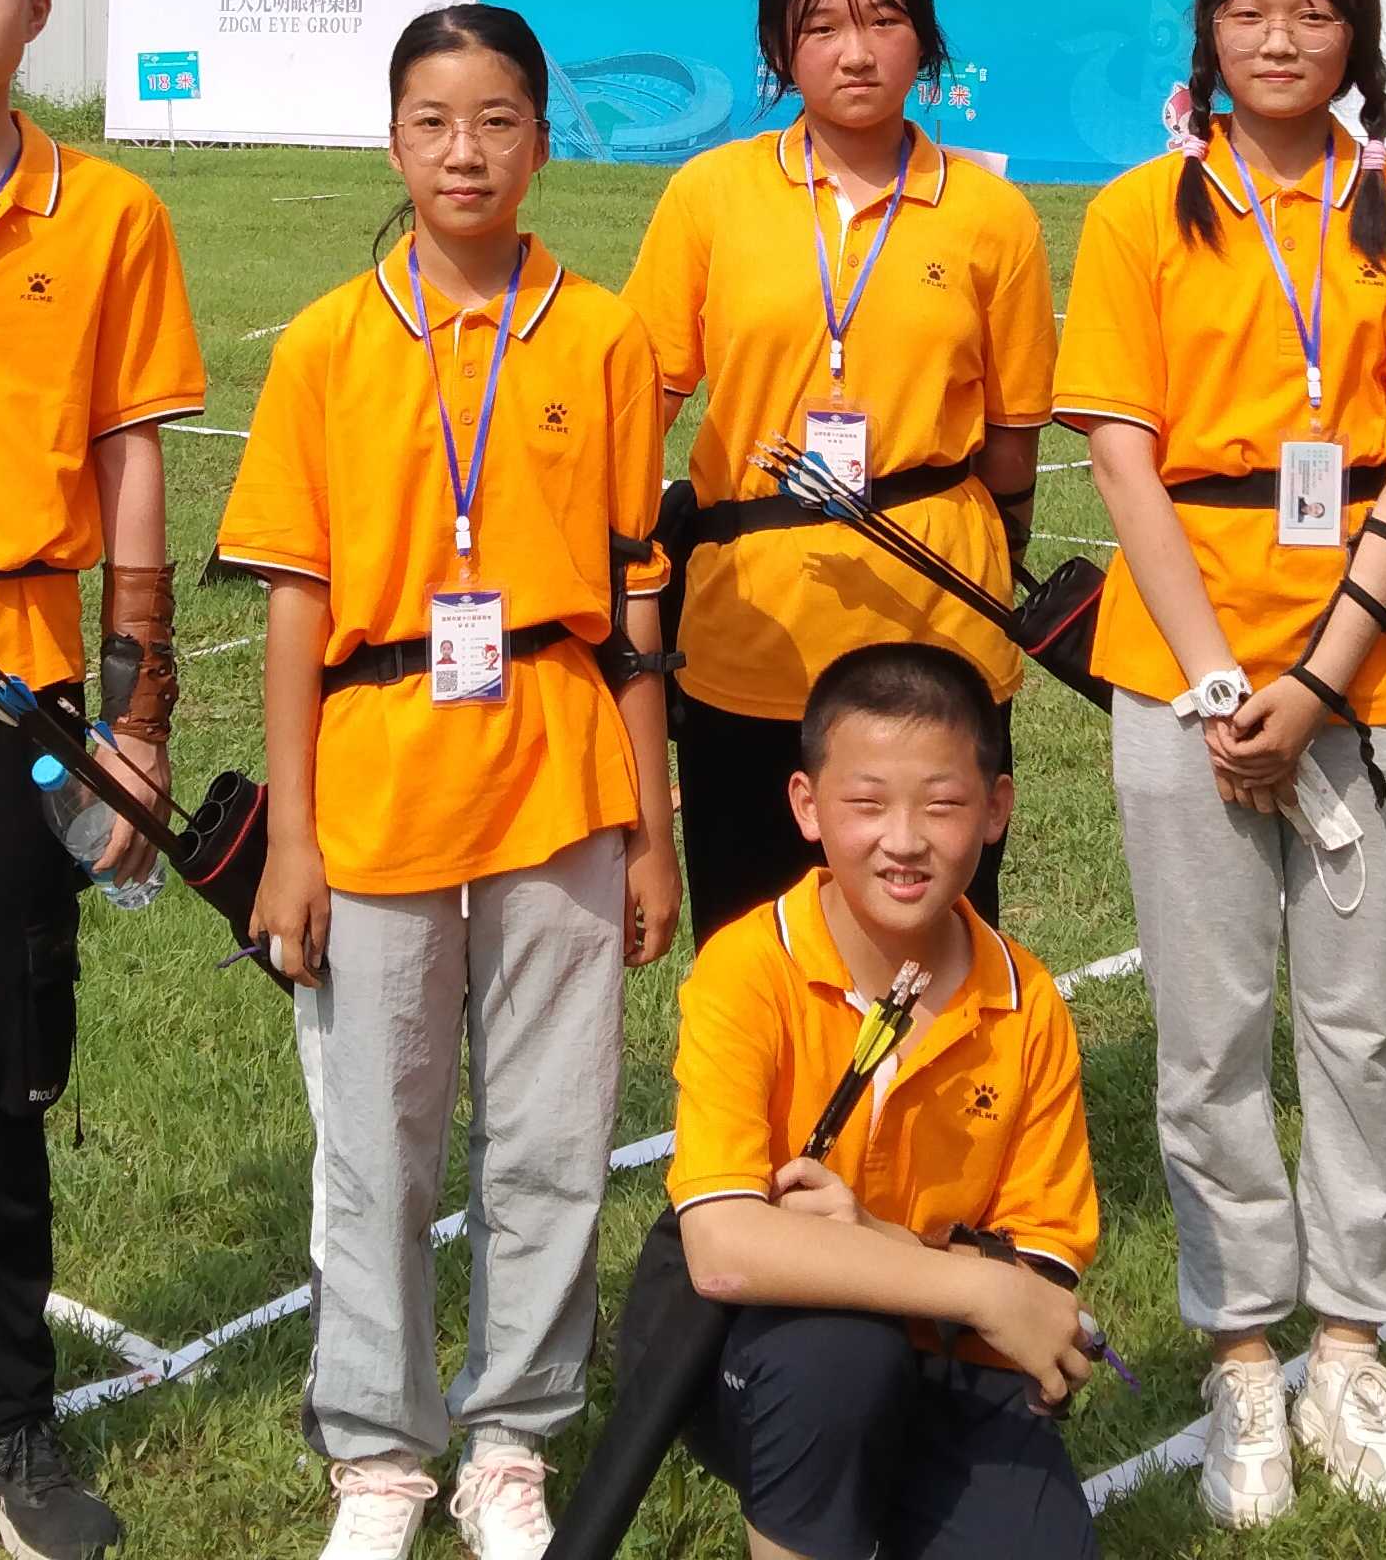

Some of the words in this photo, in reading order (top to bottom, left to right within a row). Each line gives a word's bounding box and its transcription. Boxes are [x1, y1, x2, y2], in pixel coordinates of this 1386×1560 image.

[218, 16, 261, 33] ZDGM
[268, 16, 300, 33] EYE
[307, 16, 362, 33] GROUP
[147, 73, 171, 92] 18
[948, 84, 971, 109] 米
